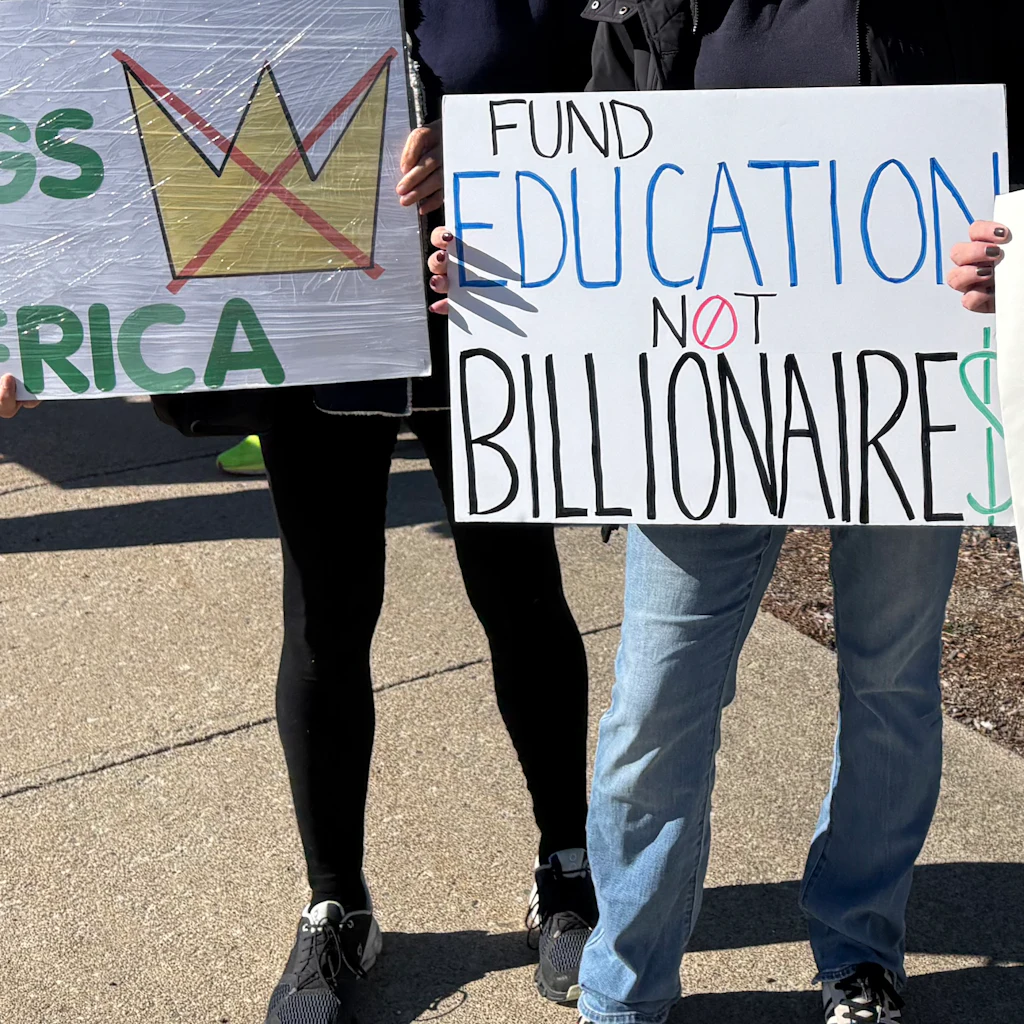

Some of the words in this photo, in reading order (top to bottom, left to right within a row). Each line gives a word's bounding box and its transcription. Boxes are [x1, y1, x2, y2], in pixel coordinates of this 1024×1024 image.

[489, 99, 653, 159] FUND
[452, 151, 1000, 290] EDUCATION
[651, 292, 777, 350] NOT
[459, 326, 1012, 525] BILLIONAIRE$
